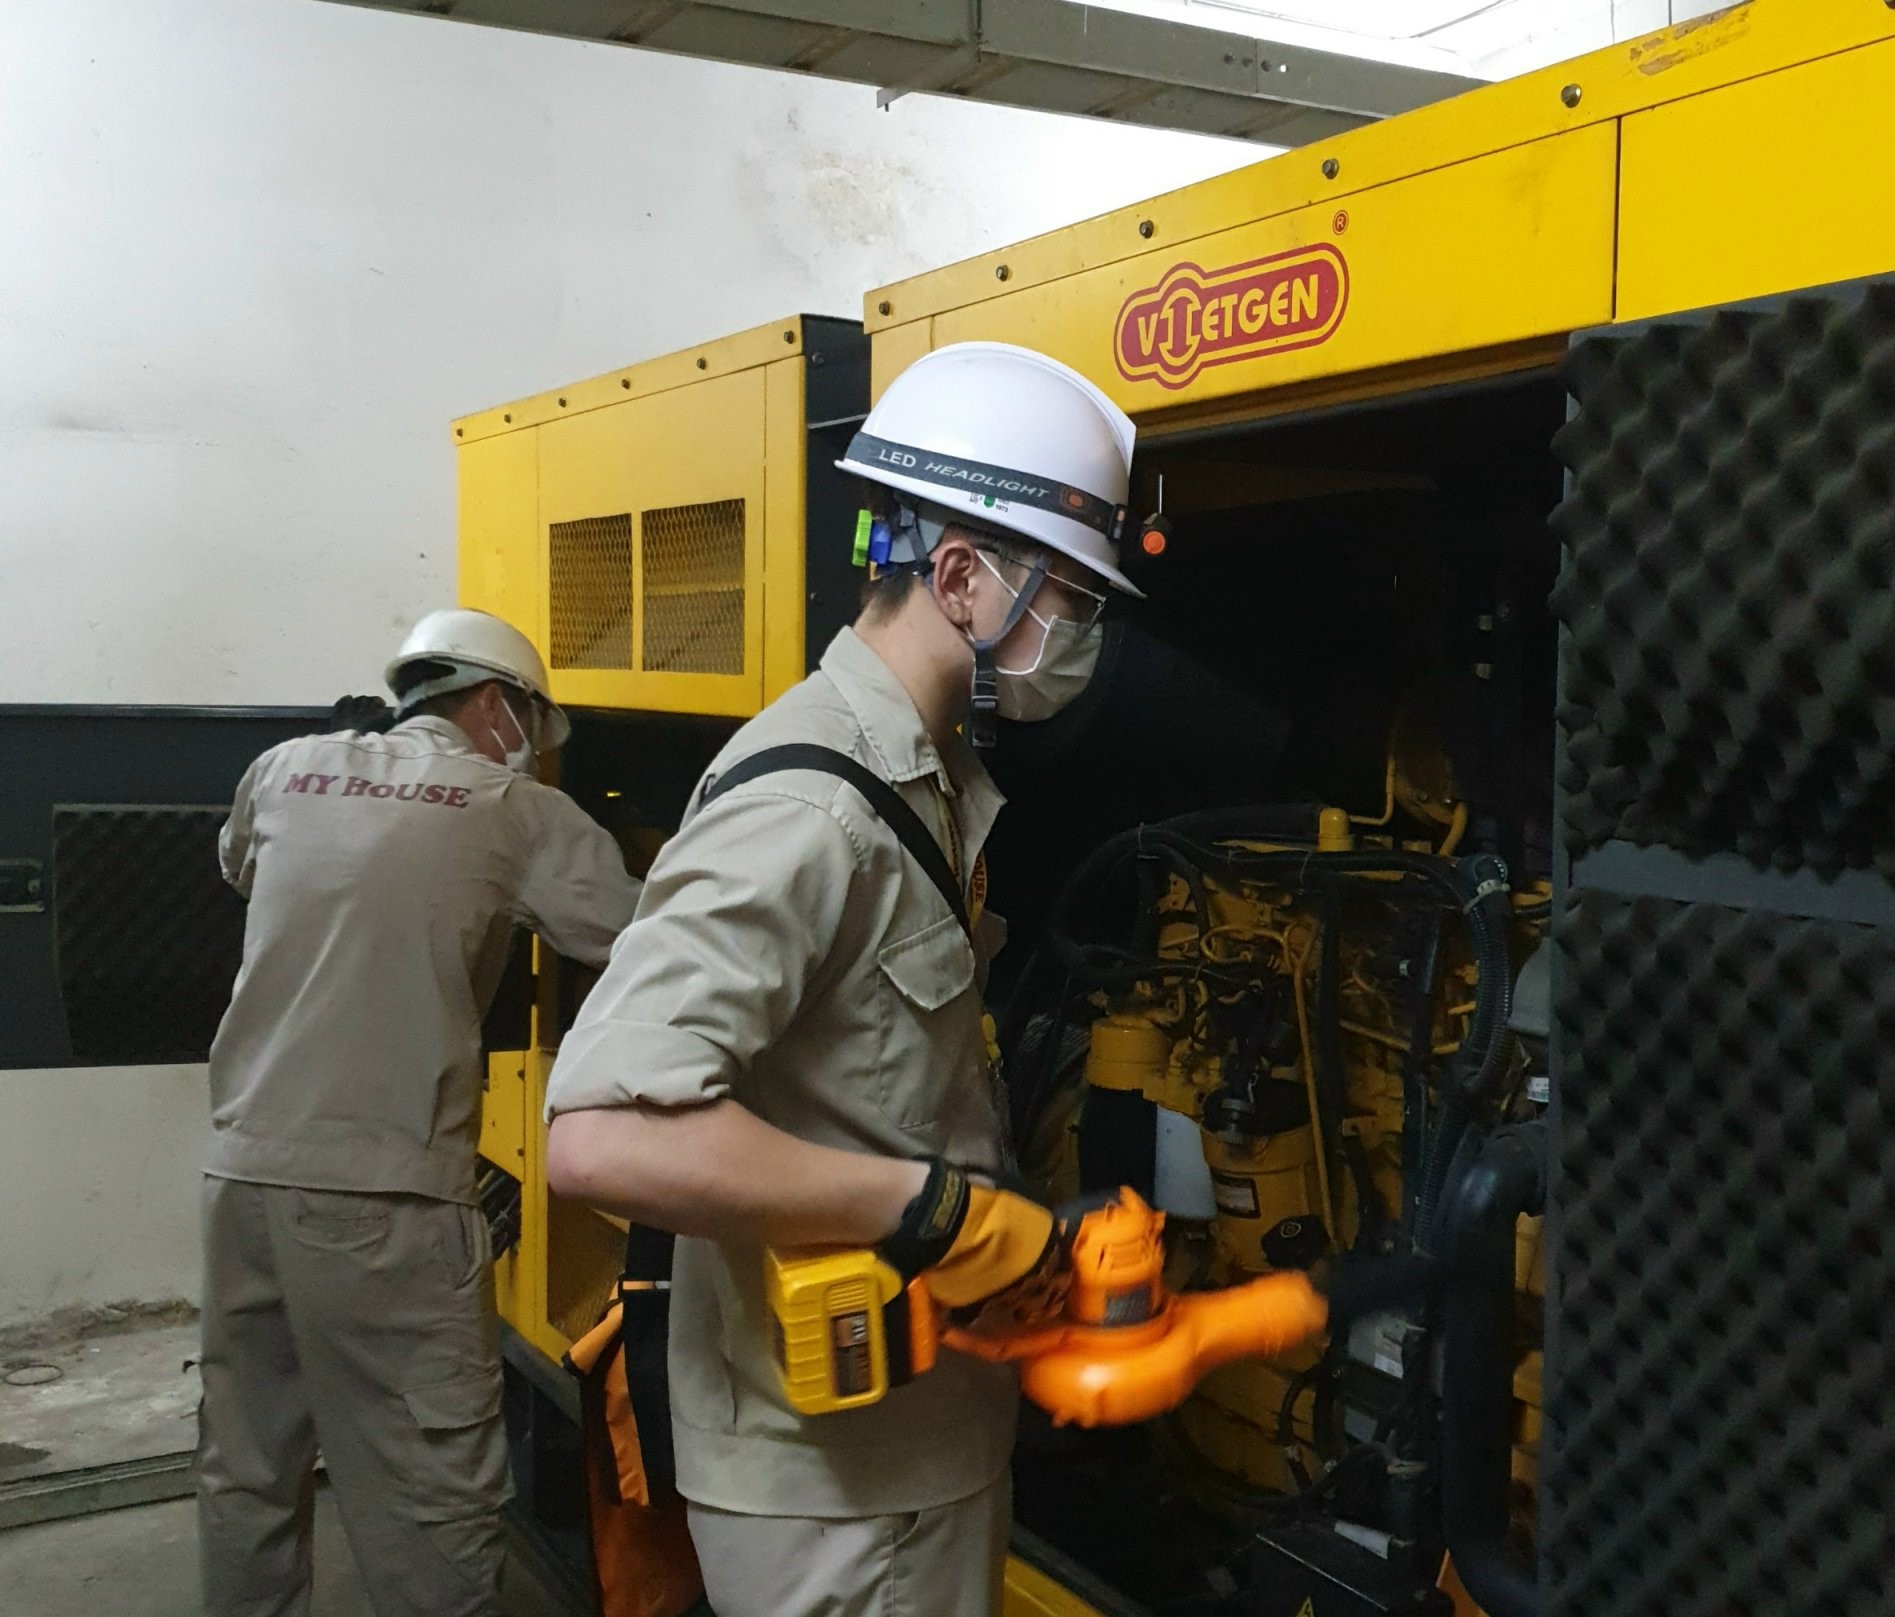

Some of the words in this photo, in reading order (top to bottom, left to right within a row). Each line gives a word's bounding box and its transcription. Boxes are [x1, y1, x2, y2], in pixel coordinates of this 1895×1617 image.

[878, 447, 917, 469] LED
[924, 461, 1050, 498] HEADLIGHT
[282, 772, 339, 796] MY
